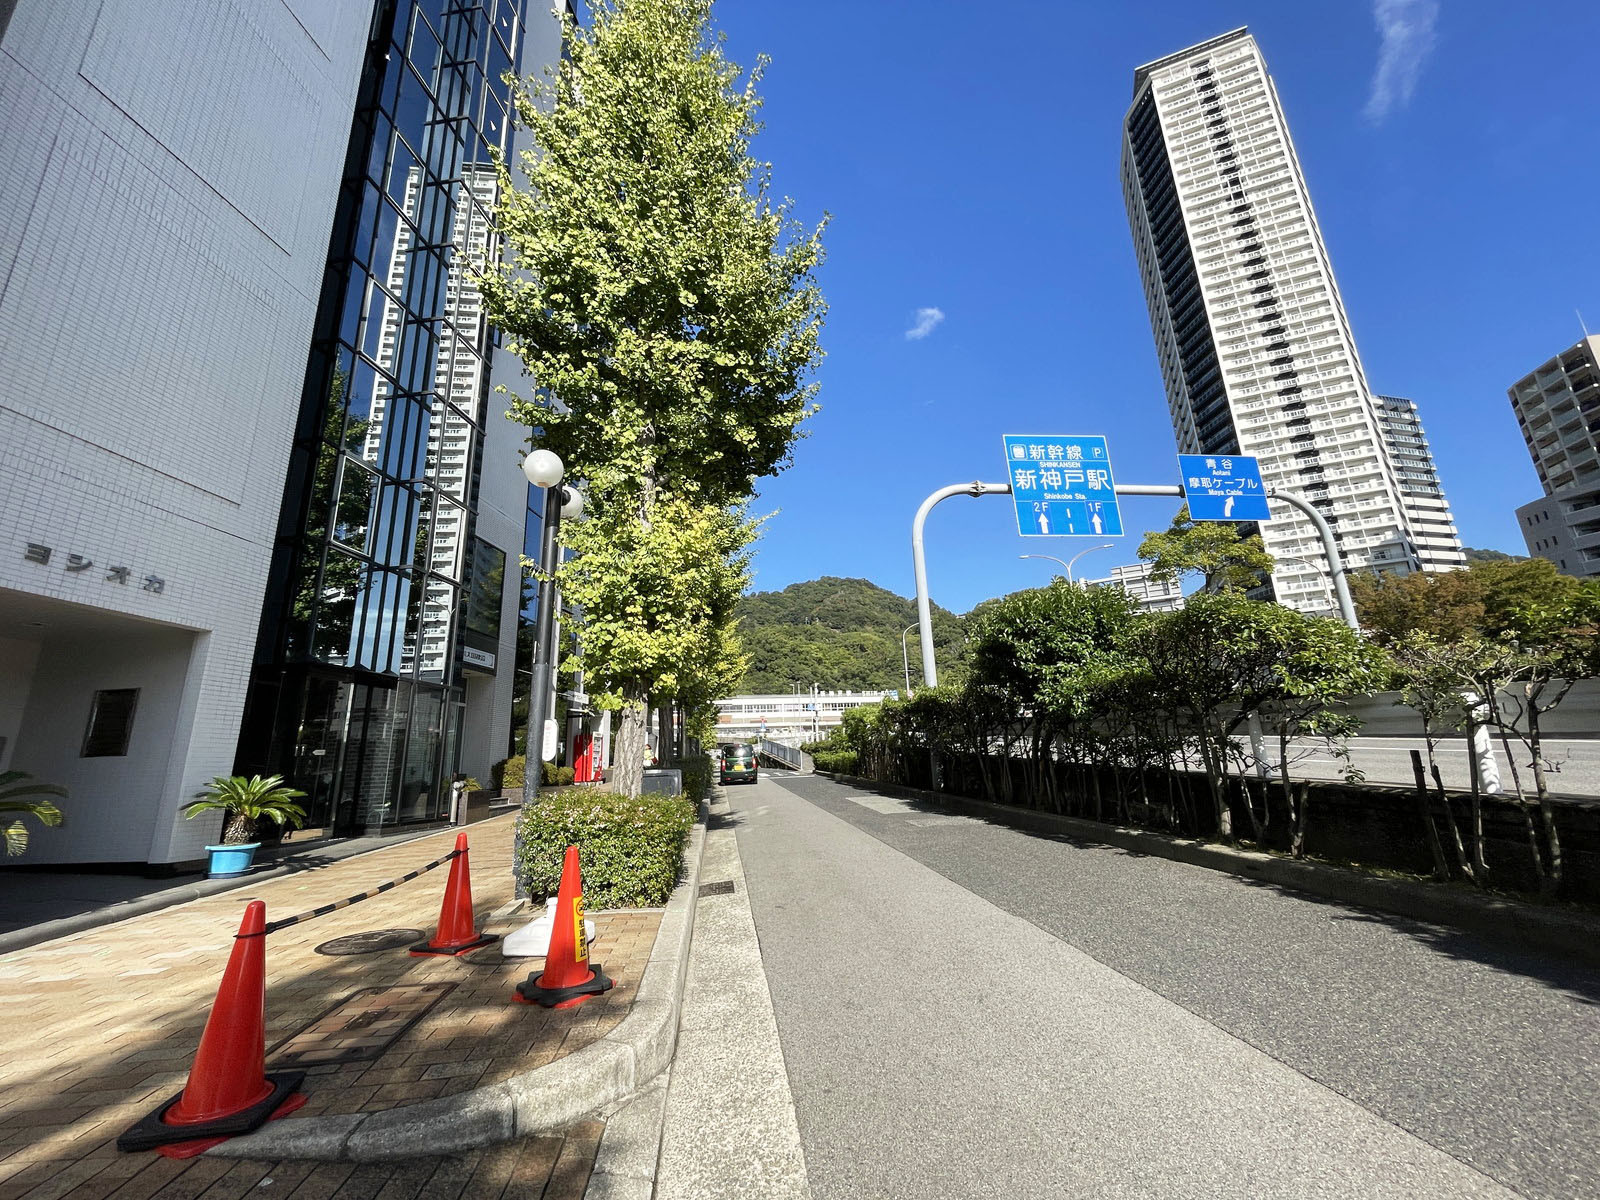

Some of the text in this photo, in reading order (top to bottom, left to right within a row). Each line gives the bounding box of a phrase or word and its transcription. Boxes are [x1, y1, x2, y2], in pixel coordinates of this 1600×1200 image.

[1028, 444, 1084, 460] 新幹線
[1206, 458, 1233, 470] 青谷
[1014, 468, 1112, 491] 新神戸駅
[1188, 477, 1258, 489] 摩耶ケーブル
[1043, 492, 1073, 500] Shinkobe
[1033, 502, 1049, 513] 2F
[1087, 502, 1103, 513] 1F
[25, 542, 165, 594] ヨシオカ
